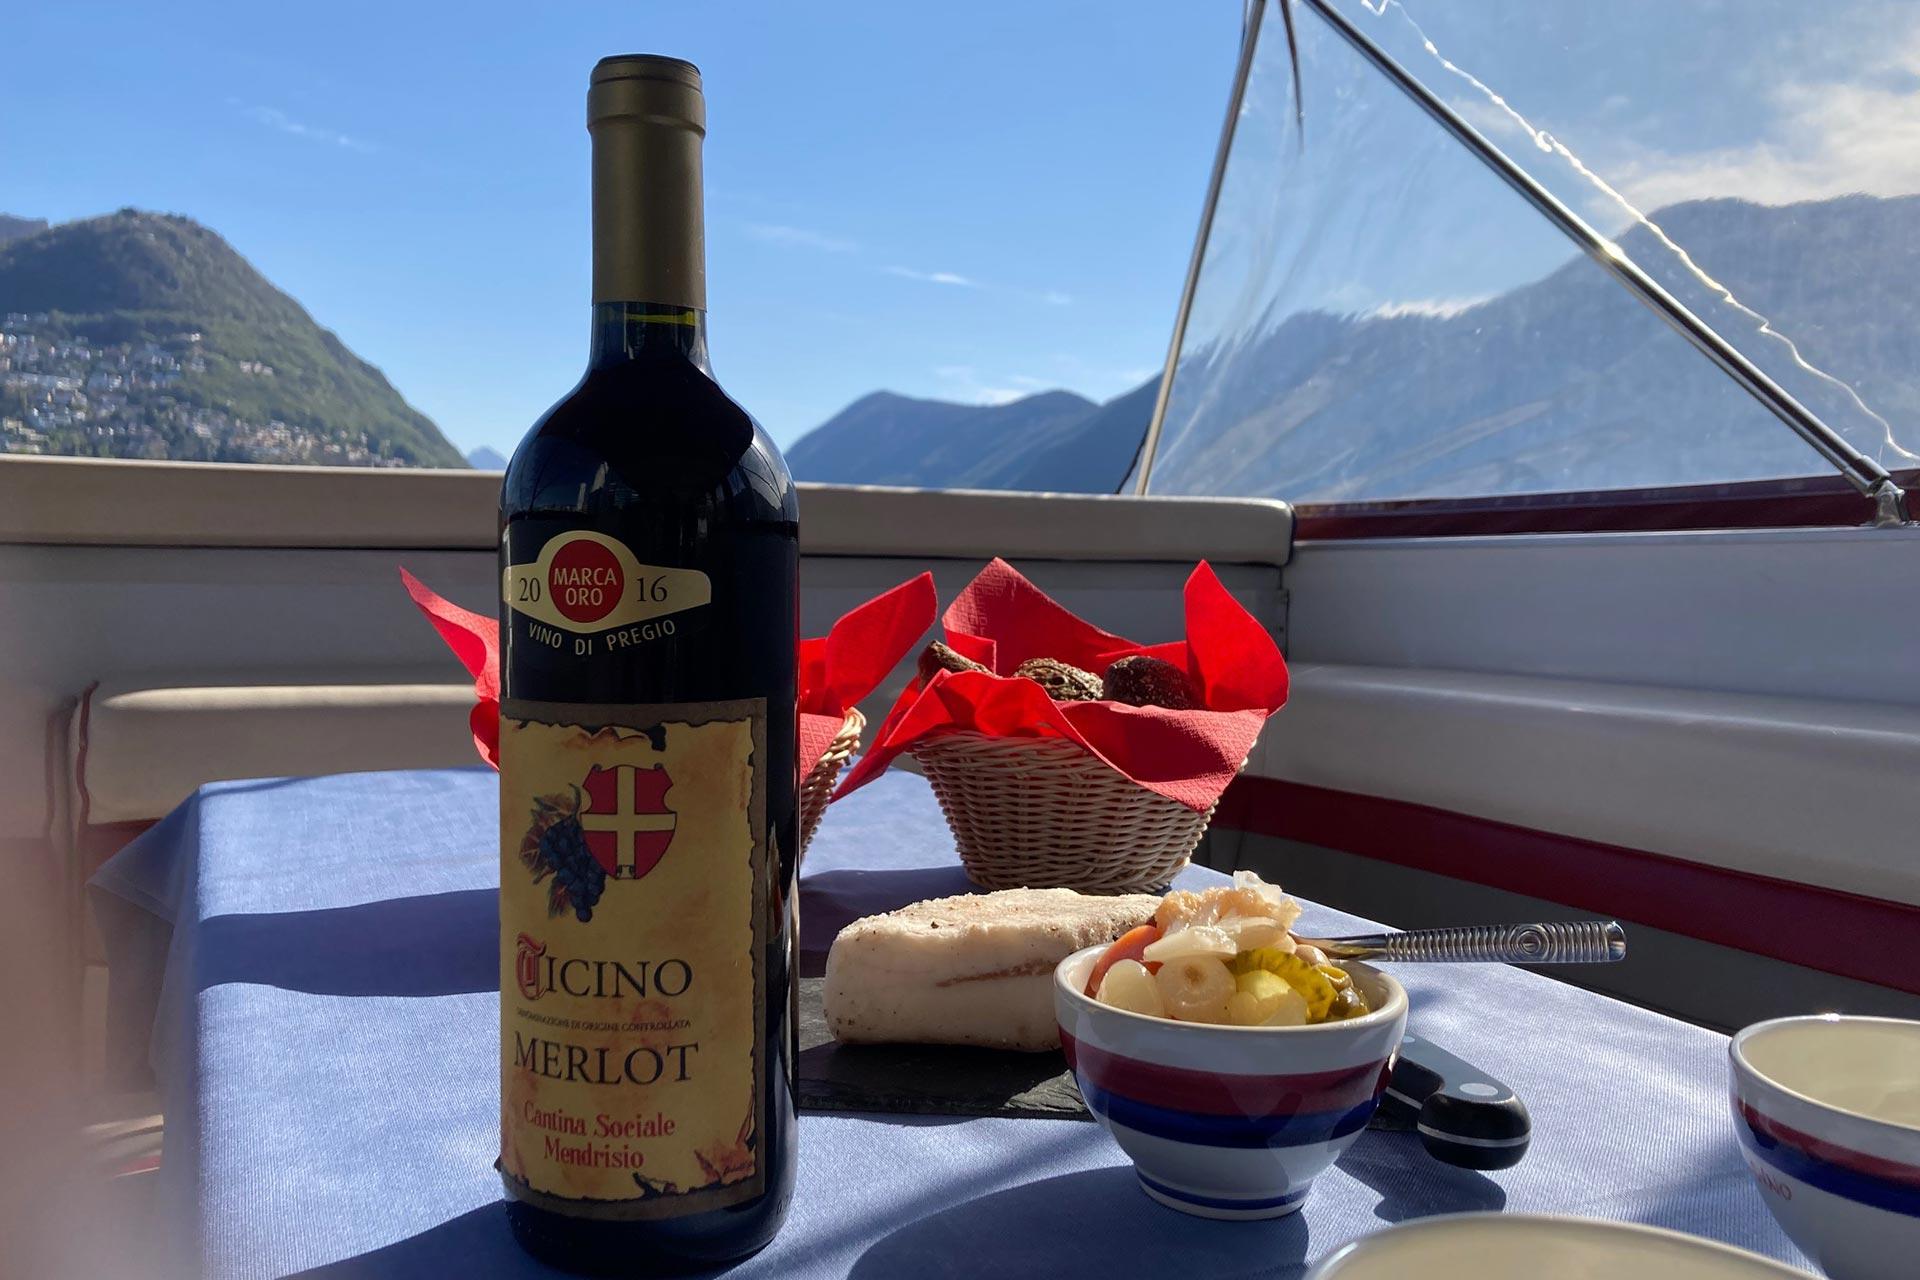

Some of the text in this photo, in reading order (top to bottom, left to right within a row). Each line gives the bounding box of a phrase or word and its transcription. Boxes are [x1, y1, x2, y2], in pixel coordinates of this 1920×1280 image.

[519, 575, 668, 602] 20 16
[553, 567, 617, 586] MARCA
[565, 588, 603, 606] ORO
[528, 618, 676, 655] VINO DI PREGIO
[515, 932, 693, 1000] TICINO
[621, 1018, 692, 1033] CONTROLLATA
[513, 1030, 699, 1086] MERLOT
[523, 1100, 675, 1139] Cantina Sociale
[543, 1135, 644, 1170] Mendrisio
